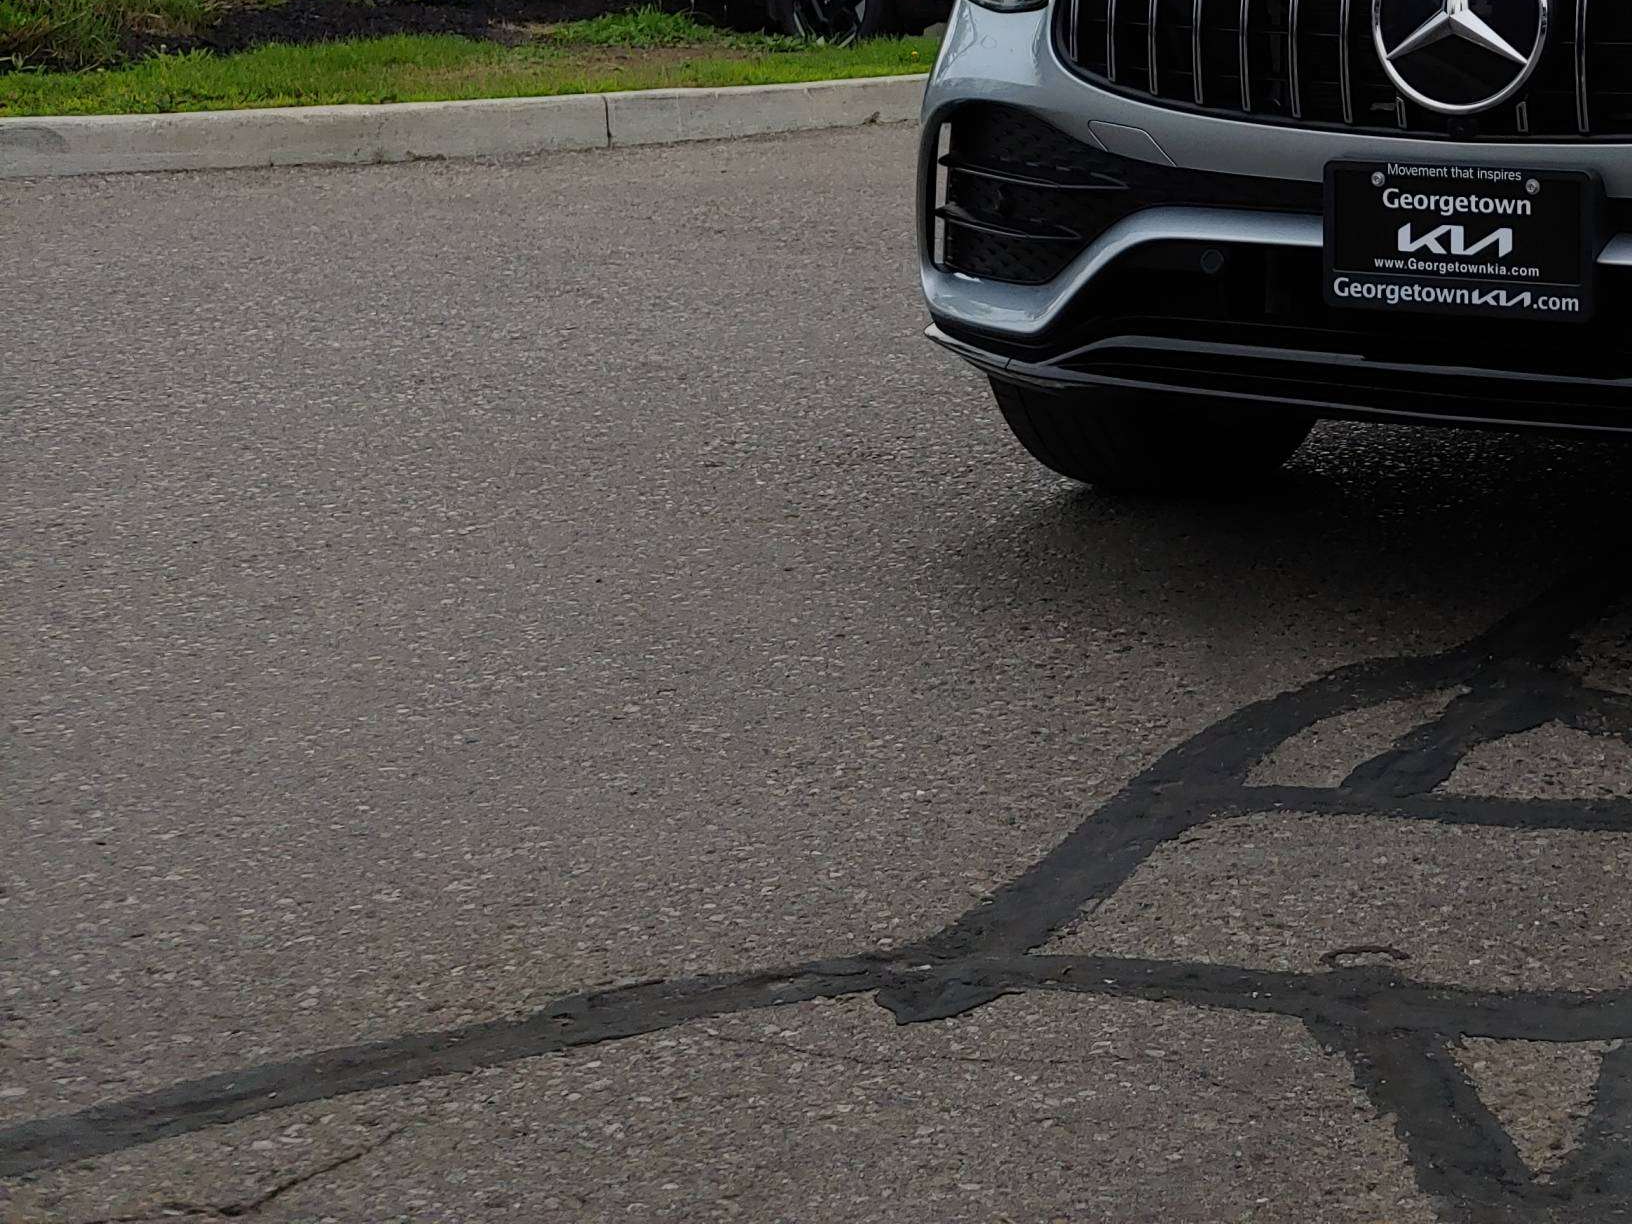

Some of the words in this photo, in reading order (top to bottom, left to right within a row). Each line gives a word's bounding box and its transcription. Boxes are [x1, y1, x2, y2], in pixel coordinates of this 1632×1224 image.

[1387, 163, 1448, 178] Movement
[1450, 165, 1474, 179] that
[1477, 167, 1522, 182] inspires
[1382, 187, 1532, 216] Georgetown
[1397, 222, 1513, 257] KIA
[1374, 257, 1540, 277] www.Georgetownkia.com
